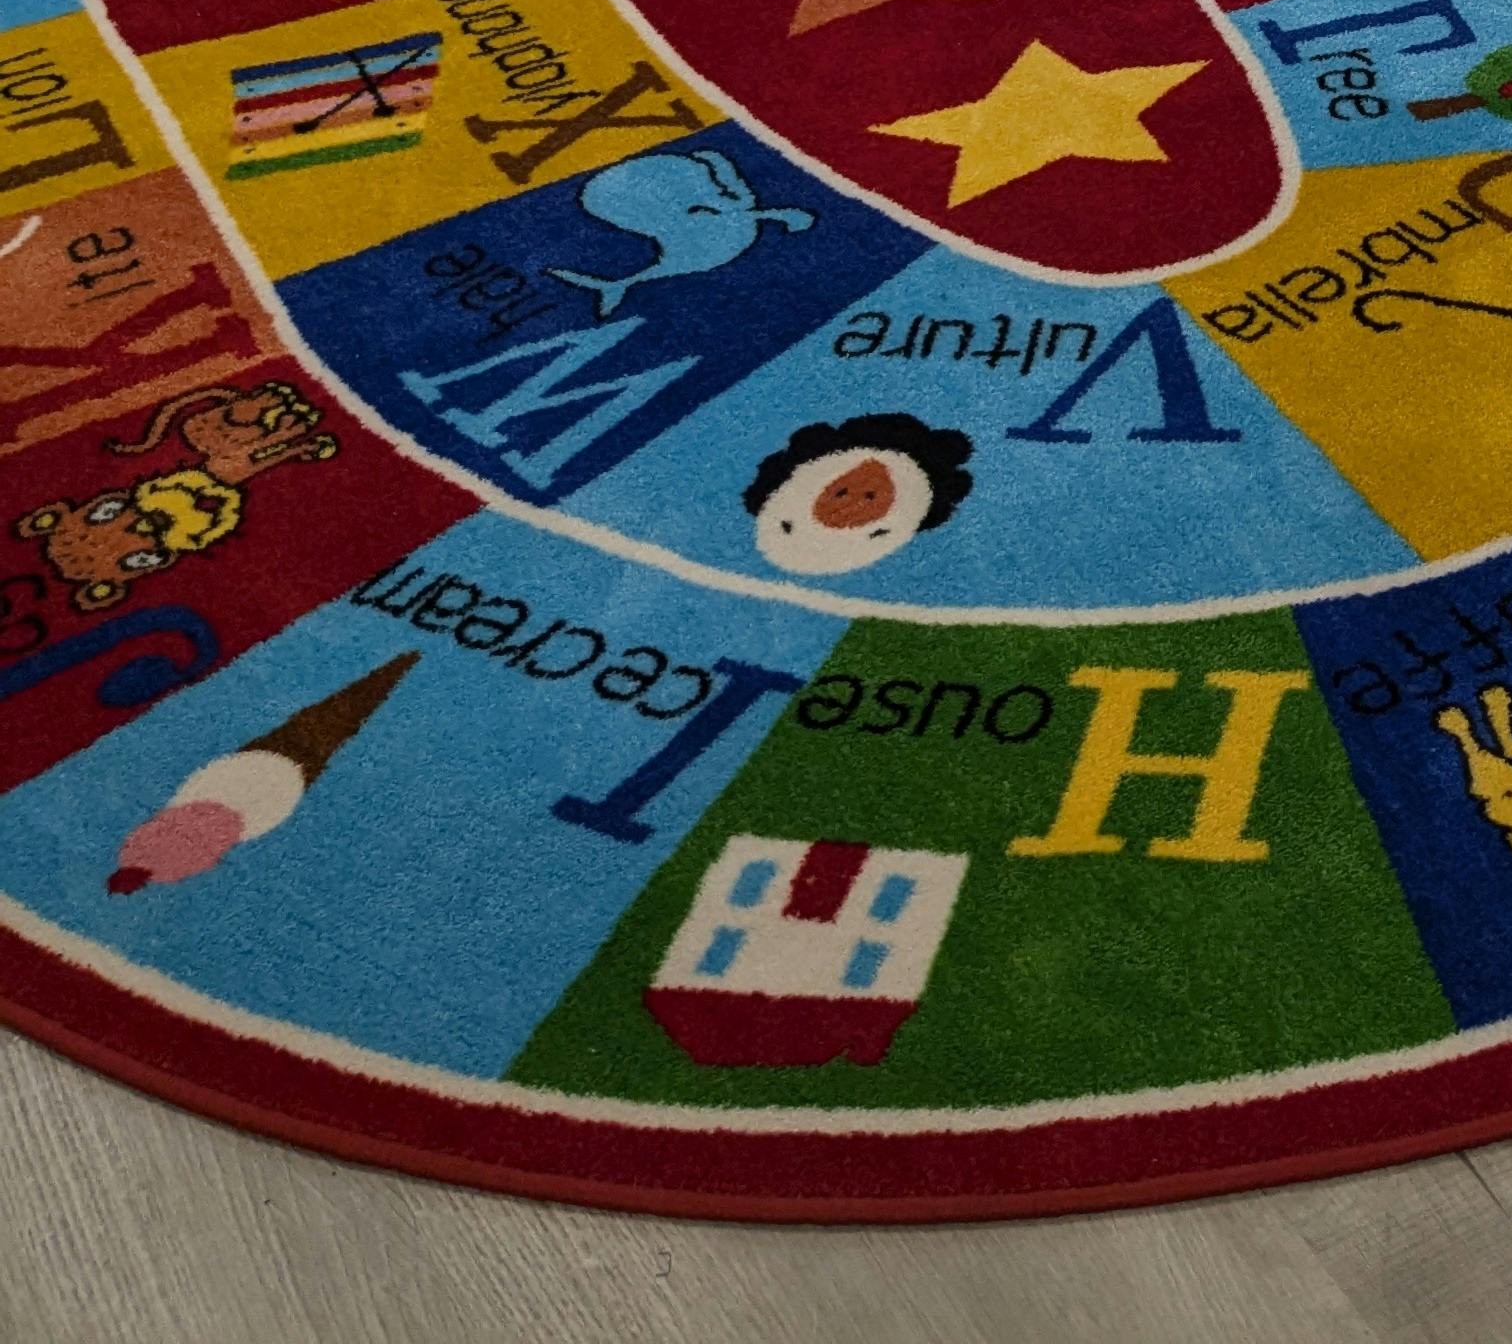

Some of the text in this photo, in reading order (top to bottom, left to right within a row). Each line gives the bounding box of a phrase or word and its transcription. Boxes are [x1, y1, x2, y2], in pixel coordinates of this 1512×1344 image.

[400, 241, 709, 490] Whale
[833, 296, 1241, 446] Vulture
[797, 664, 1316, 865] House
